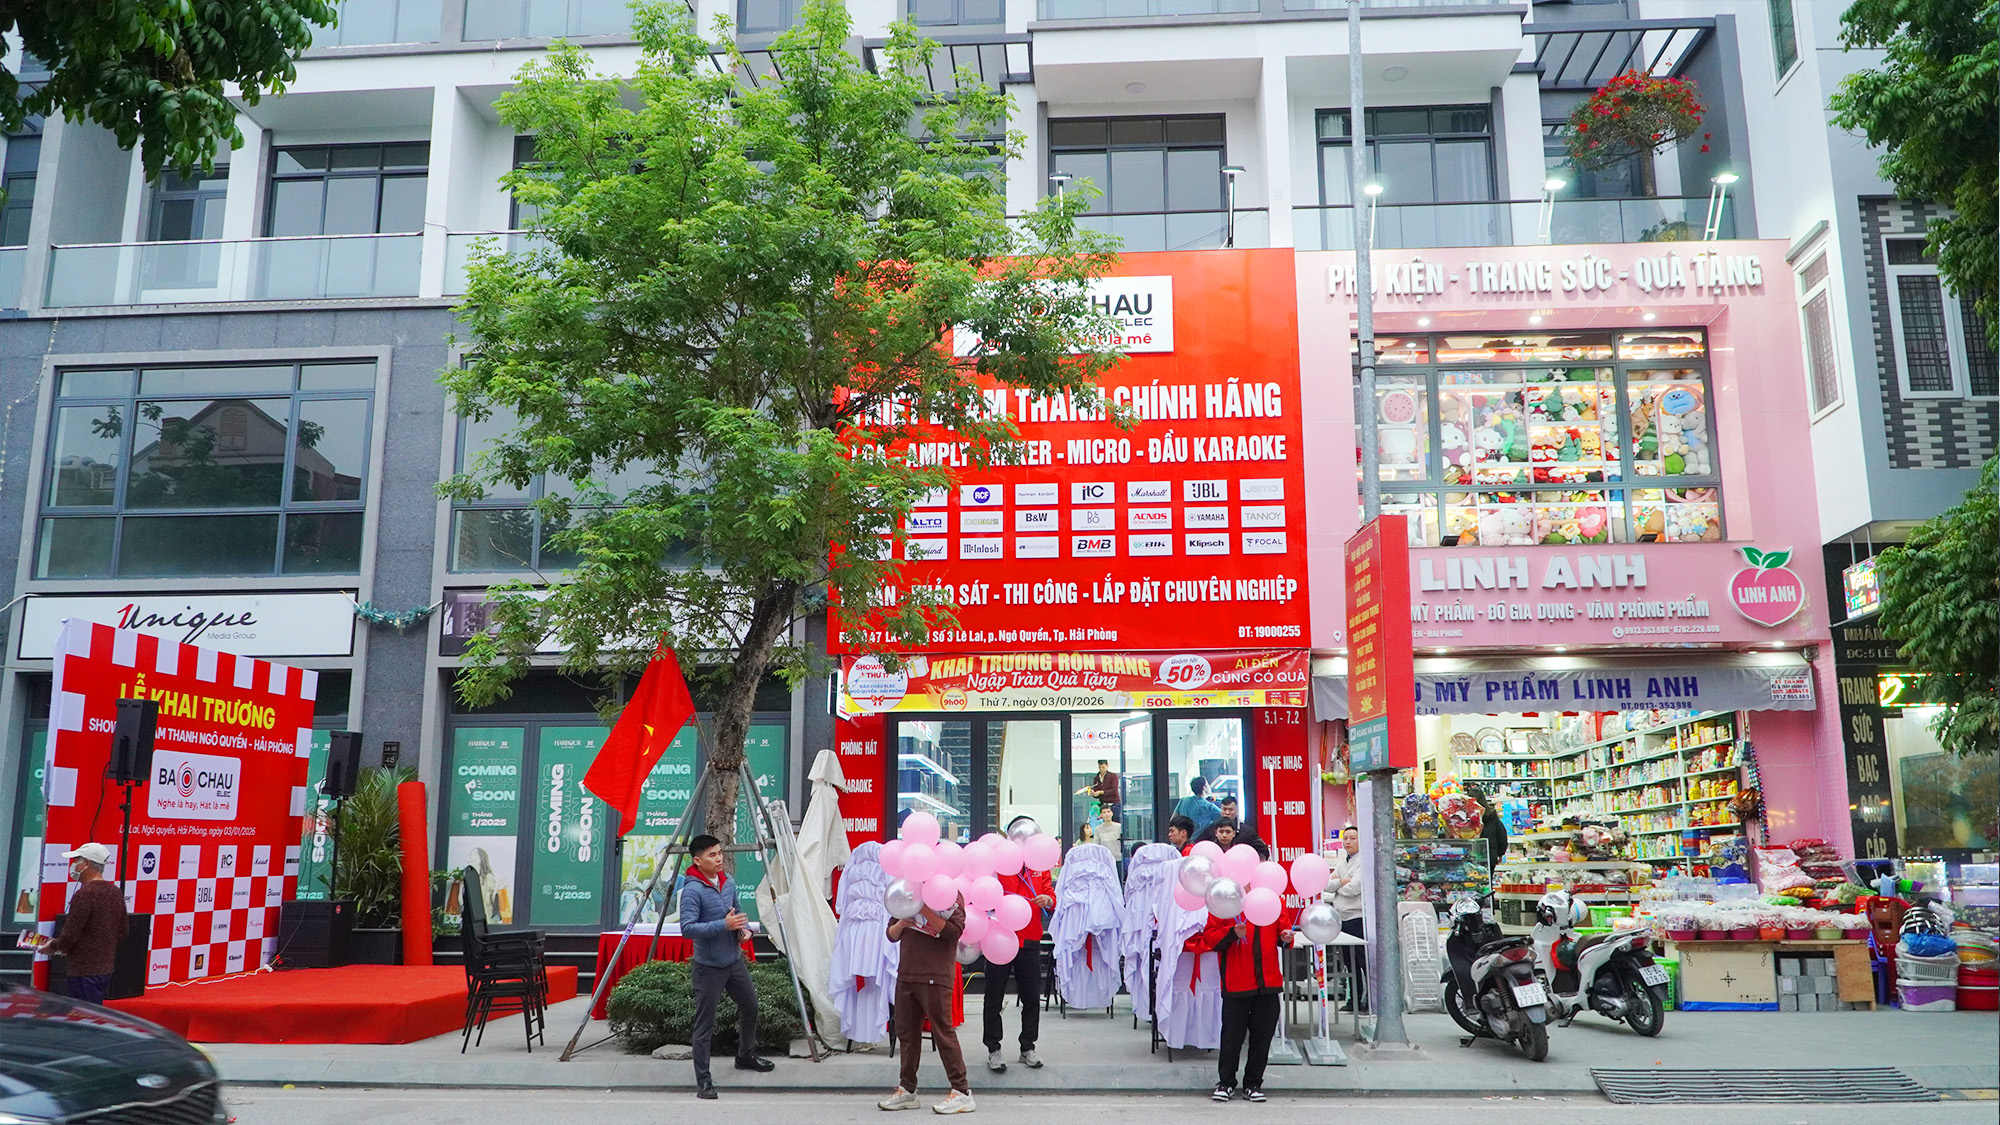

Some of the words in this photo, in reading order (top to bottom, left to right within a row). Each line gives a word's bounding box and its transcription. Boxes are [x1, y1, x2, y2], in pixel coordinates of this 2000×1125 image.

[1386, 255, 1444, 304] KIỆN
[1465, 259, 1553, 294] TRANG
[1561, 252, 1613, 292] SỨC
[1634, 249, 1687, 293] QUÀ
[1691, 247, 1763, 295] TẶNG
[1127, 332, 1152, 344] mê
[1113, 378, 1198, 421] CHÍNH
[1205, 376, 1283, 419] HÃNG
[906, 441, 971, 468] AMPLY
[1067, 438, 1131, 465] MICRO
[1148, 428, 1188, 464] ĐẦU
[1193, 434, 1287, 463] KARAOKE
[974, 491, 990, 500] RCF
[1131, 487, 1168, 498] Marshall
[1194, 482, 1220, 499] JBL
[912, 518, 943, 526] ALTO
[1025, 512, 1048, 522] B&W
[1133, 512, 1168, 520] ACNOS
[1196, 513, 1226, 522] YAMAHA
[1244, 512, 1282, 521] TANNOY
[1077, 539, 1112, 550] BMB
[1189, 539, 1225, 549] Klipsch
[1420, 555, 1529, 592] LINH
[1542, 554, 1648, 590] ANH
[959, 579, 990, 606] SÁT
[1003, 583, 1029, 605] THI
[1033, 578, 1078, 605] CÔNG
[1093, 573, 1126, 604] LẮP
[1129, 576, 1161, 608] ĐẶT
[1165, 575, 1233, 603] CHUYÊN
[1236, 574, 1298, 605] NGHIỆP
[1737, 586, 1768, 604] LINH
[1769, 584, 1797, 603] ANH
[1411, 601, 1430, 622] MỸ
[1435, 597, 1475, 622] PHẨM
[1487, 600, 1506, 621] ĐỒ
[1509, 603, 1533, 621] GIA
[1537, 602, 1575, 624] DỤNG
[1586, 599, 1615, 620] VĂN
[1618, 596, 1666, 620] PHÒNG
[1667, 593, 1710, 618] PHẨM
[207, 632, 232, 640] Media
[232, 632, 257, 642] Group
[932, 628, 945, 643] Số
[947, 631, 954, 642] 3
[955, 629, 967, 643] Lê
[969, 630, 987, 644] Lai,
[988, 632, 998, 644] p.
[999, 629, 1018, 644] Ngô
[1019, 627, 1052, 644] Quyền,
[1053, 629, 1068, 643] Tp.
[1069, 627, 1085, 641] Hải
[1087, 627, 1118, 643] Phòng
[1238, 625, 1254, 638] ĐT:
[1254, 625, 1301, 638] 19000255
[1427, 627, 1440, 638] HẢI
[1440, 626, 1463, 638] PHÒNG
[1847, 649, 1867, 659] ĐC:
[1868, 648, 1876, 658] 5
[1878, 645, 1894, 659] LÊ
[930, 656, 974, 681] KHAI
[980, 651, 1052, 673] TRƯƠNG
[1235, 659, 1249, 669] AI
[1251, 654, 1279, 669] ĐẾN
[967, 671, 1008, 691] Ngập
[1011, 670, 1044, 687] Tràn
[1048, 671, 1078, 688] Quà
[1082, 670, 1118, 690] Tặng
[1211, 669, 1251, 684] CŨNG
[1253, 669, 1273, 683] CÓ
[1276, 668, 1306, 683] QUÀ
[1435, 677, 1471, 702] MỸ
[1485, 671, 1560, 702] PHẨM
[1572, 678, 1632, 701] LINH
[1646, 676, 1699, 698] ANH
[1840, 677, 1876, 705] TRANG
[151, 688, 198, 720] KHAI
[202, 695, 276, 730] TRƯƠNG
[979, 697, 999, 707] Thứ
[1012, 697, 1038, 709] ngày
[1040, 696, 1105, 707] 03/01/2026
[1192, 697, 1209, 706] 30
[1237, 697, 1250, 706] 15
[1264, 711, 1278, 725] 5.1
[1286, 711, 1300, 725] 7.2
[1852, 708, 1874, 744] SỨC
[167, 727, 199, 744] THANH
[199, 730, 219, 746] NGÔ
[219, 731, 248, 749] QUYỀN
[254, 735, 267, 752] HẢI
[267, 738, 294, 755] PHÒNG
[840, 740, 863, 756] PHÒNG
[864, 739, 878, 755] HÁT
[458, 765, 517, 776] COMING
[1262, 755, 1282, 770] NGHE
[1283, 755, 1303, 772] NHẠC
[1857, 754, 1880, 787] BẠC
[198, 771, 234, 790] CHAU
[216, 790, 231, 798] ELEC
[472, 790, 516, 801] SOON
[646, 789, 691, 800] SOON
[157, 798, 175, 810] Nghe
[177, 799, 183, 808] là
[184, 799, 199, 812] hay,
[200, 800, 212, 810] Hát
[219, 801, 230, 811] mê
[547, 763, 565, 853] COMING
[1284, 801, 1306, 816] HIEND
[470, 818, 507, 827] 1/2025
[577, 797, 594, 863] SOON
[855, 818, 878, 832] DOANH
[141, 824, 155, 835] Ngô
[155, 823, 176, 837] quyền,
[177, 823, 188, 835] Hải
[188, 824, 209, 838] Phòng,
[208, 826, 223, 838] ngày
[223, 826, 257, 837] 03/01/2026
[1865, 828, 1887, 859] CẤP
[142, 857, 156, 868] RCF
[158, 893, 176, 901] ALTO
[199, 887, 213, 903] JBL
[554, 891, 592, 900] 1/2025
